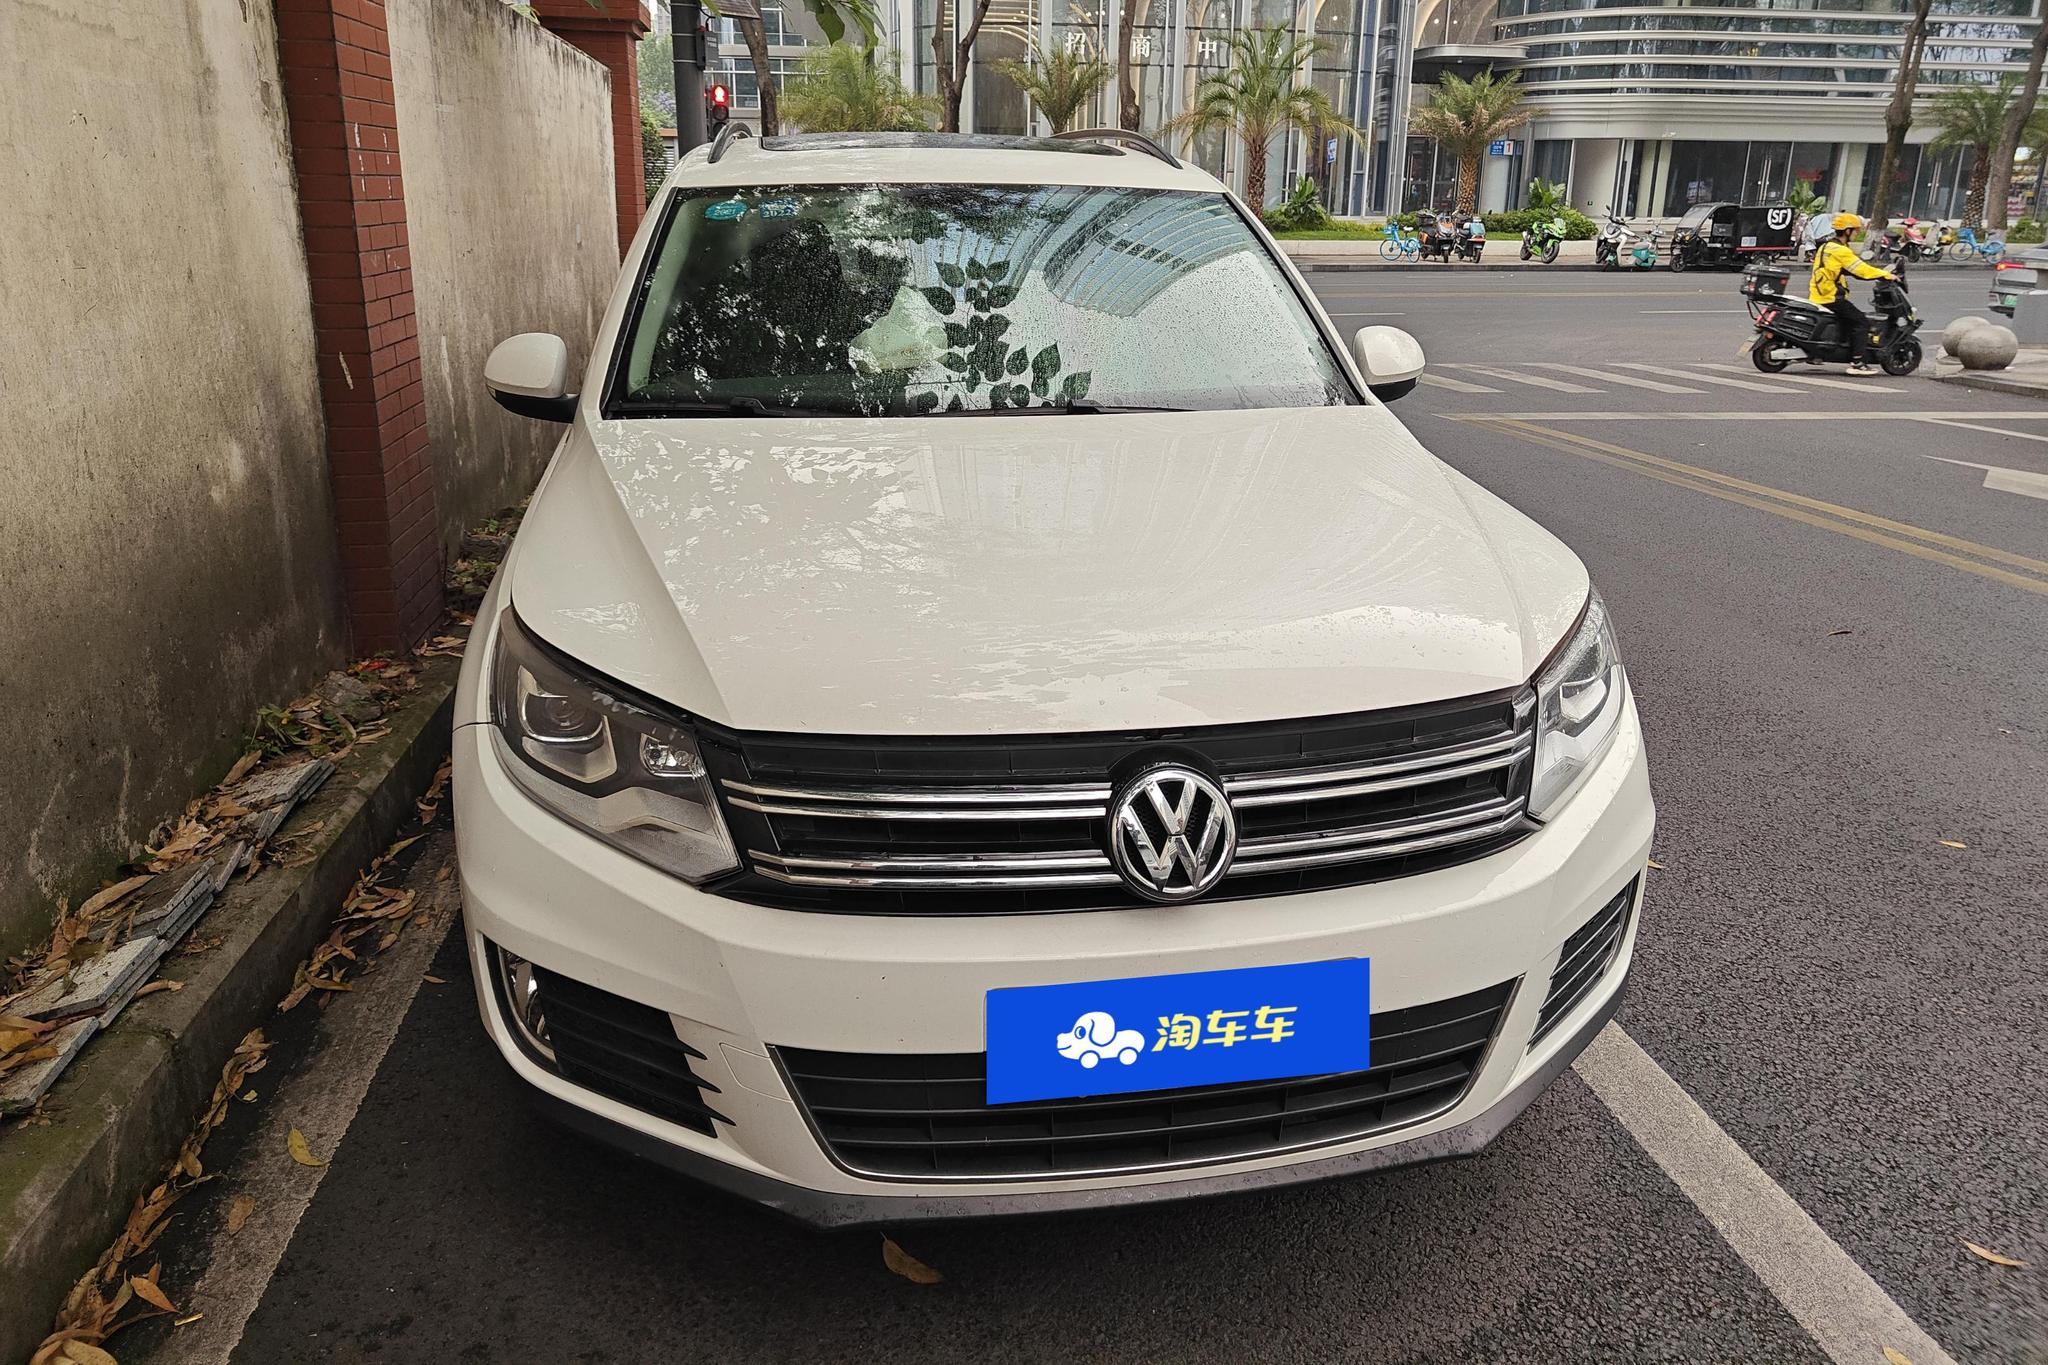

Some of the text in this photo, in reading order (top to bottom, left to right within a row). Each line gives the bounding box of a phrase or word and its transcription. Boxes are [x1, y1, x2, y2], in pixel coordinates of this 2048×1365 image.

[763, 209, 792, 217] 2022
[1771, 209, 1787, 223] SF
[1116, 774, 1230, 895] VW
